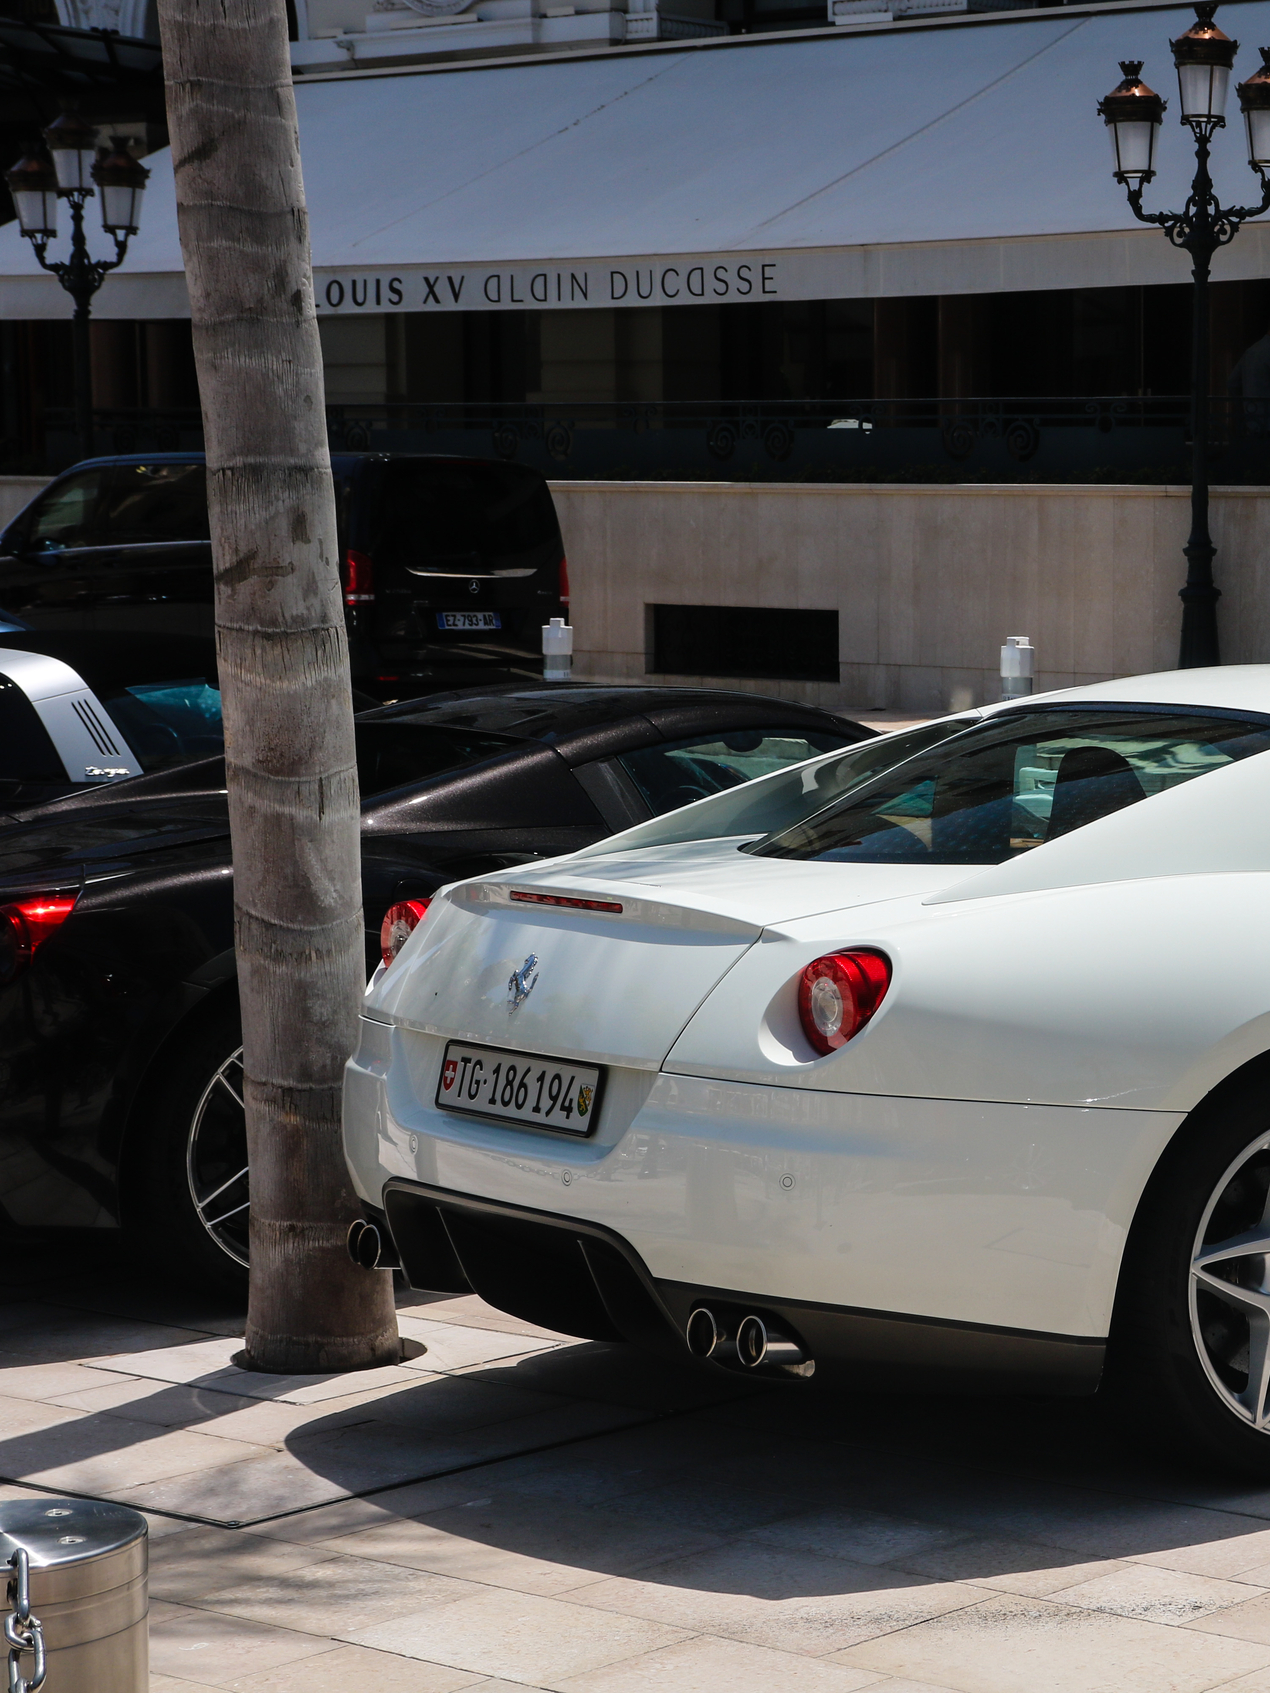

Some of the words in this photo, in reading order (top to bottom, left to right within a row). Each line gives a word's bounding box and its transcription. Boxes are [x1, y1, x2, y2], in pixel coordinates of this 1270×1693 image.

[315, 277, 403, 308] OUIS
[423, 275, 465, 304] XV
[444, 613, 495, 627] EZ-793-AR
